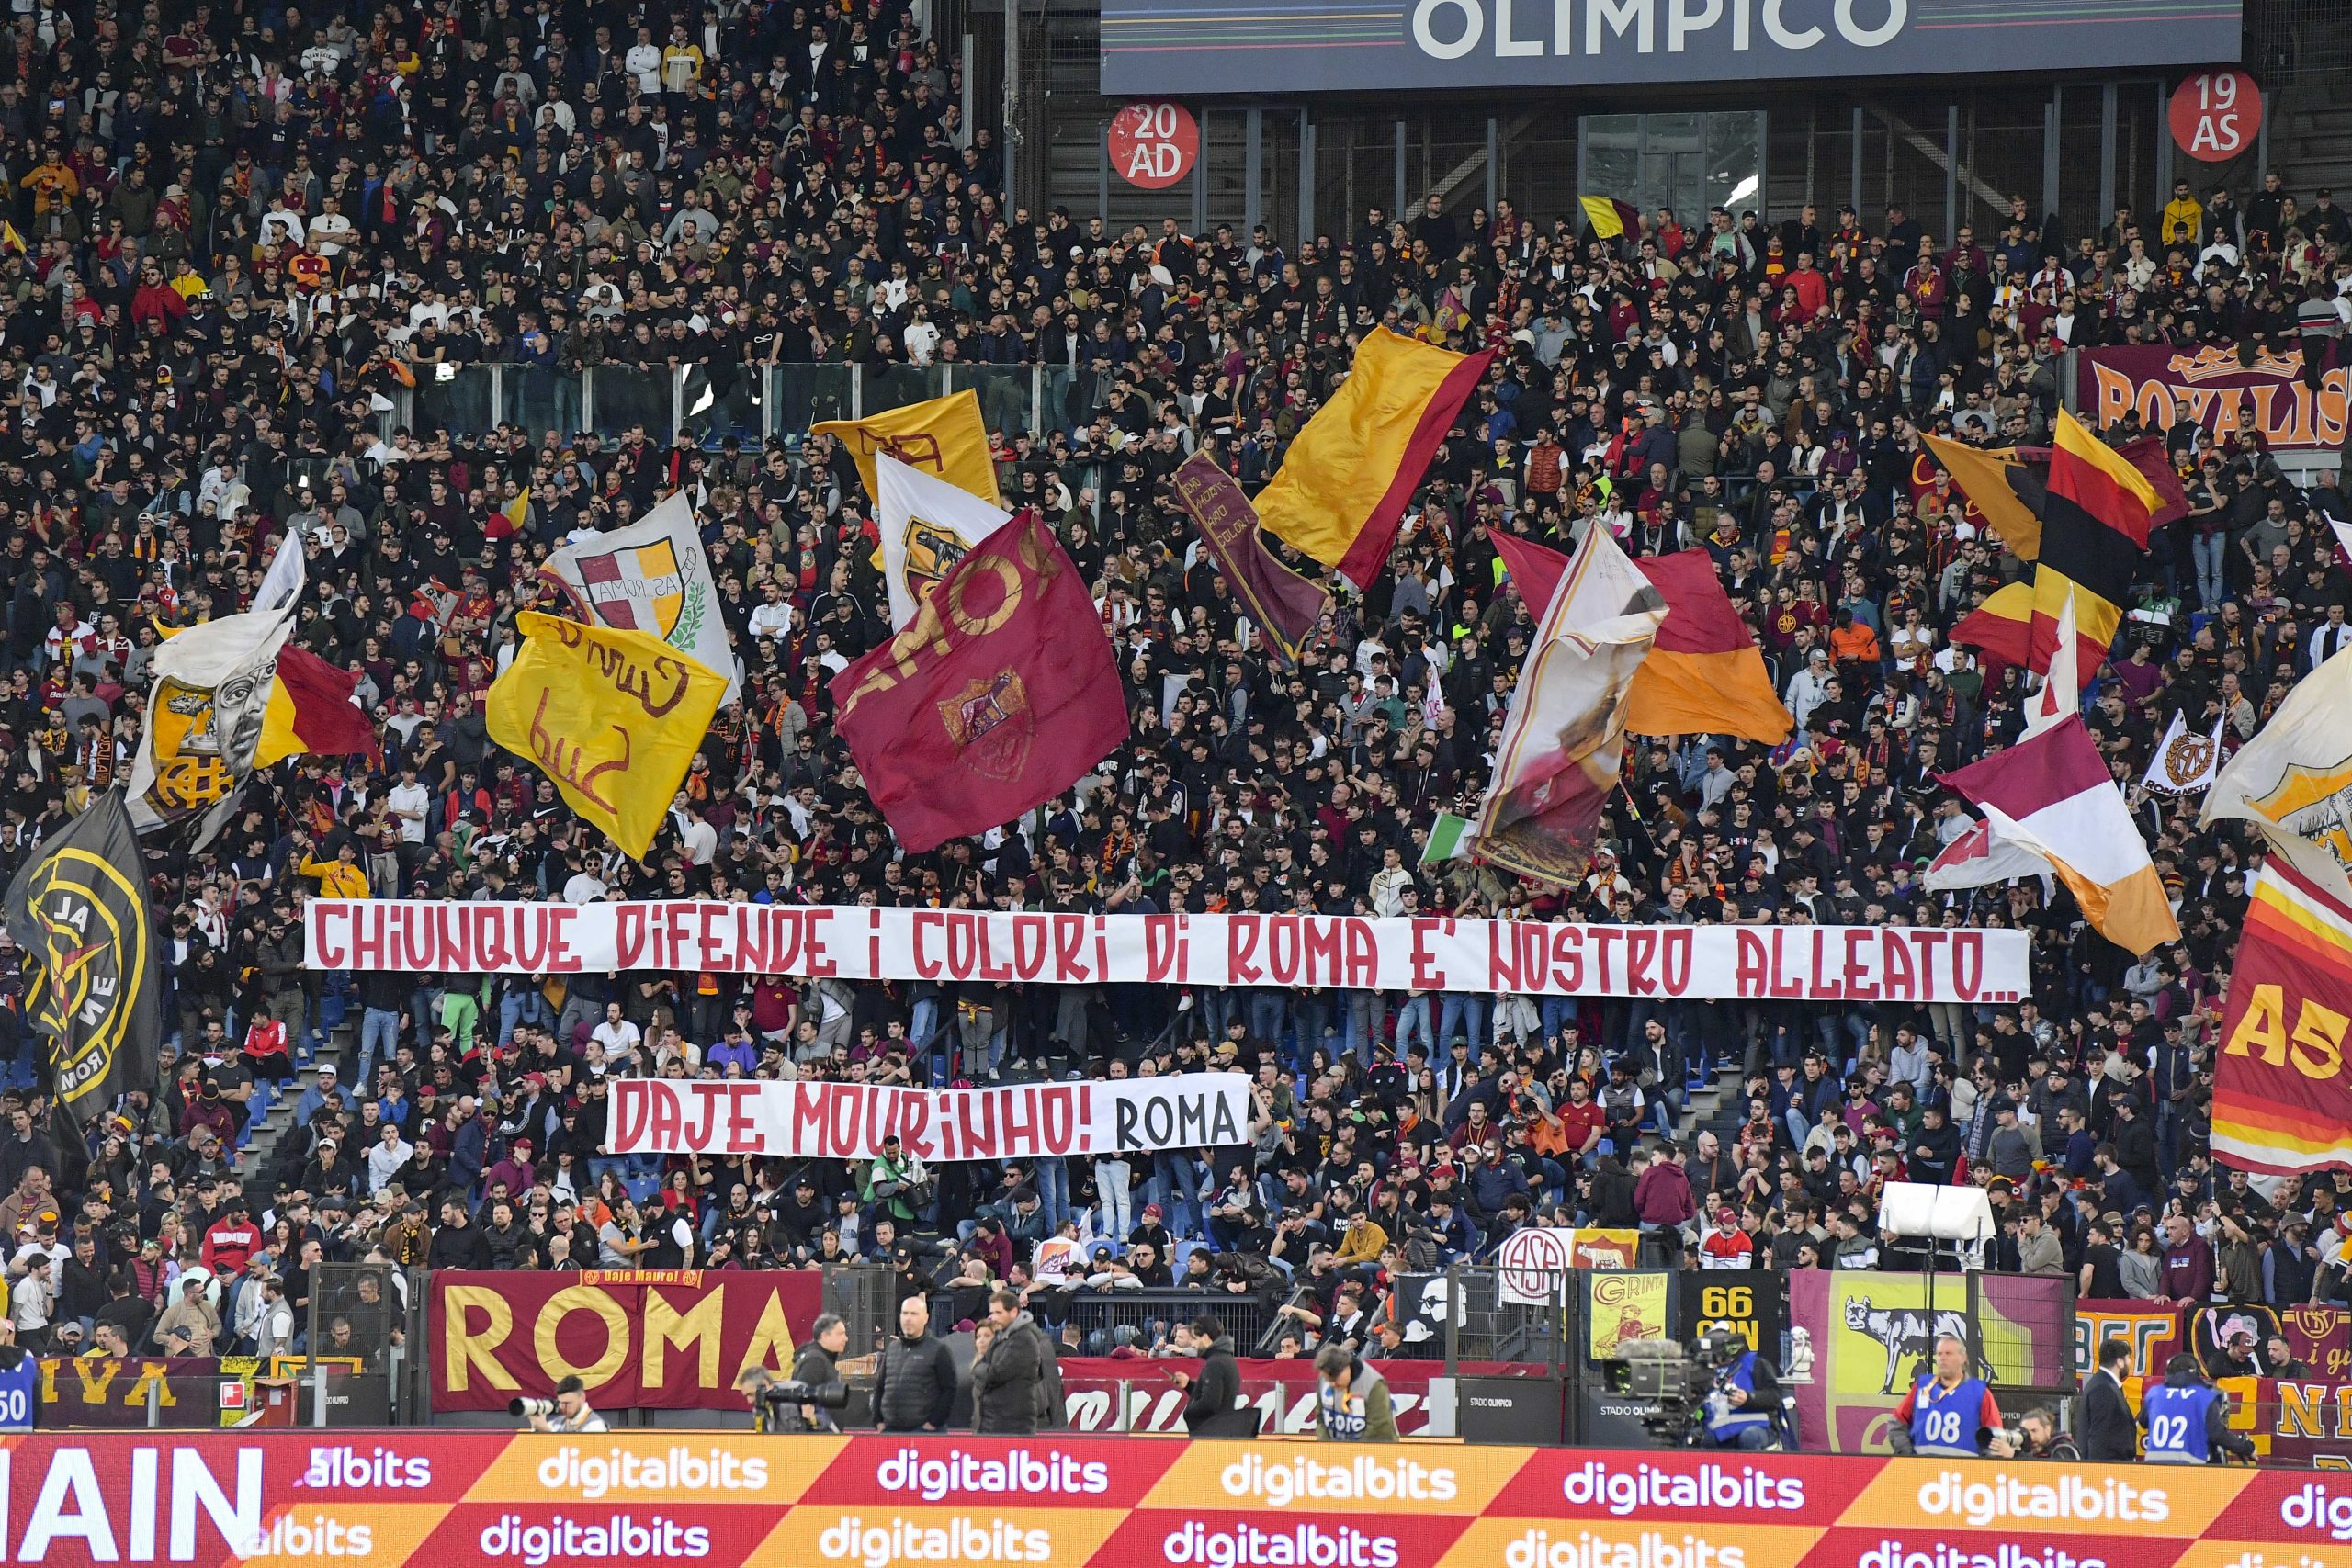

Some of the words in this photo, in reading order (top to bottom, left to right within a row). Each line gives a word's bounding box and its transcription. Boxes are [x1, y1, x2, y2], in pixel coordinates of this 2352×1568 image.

[1412, 0, 1908, 59] OLIMPICO
[2194, 73, 2237, 110] 19
[1134, 103, 1177, 139] 20
[2190, 114, 2240, 152] AS
[1127, 143, 1182, 178] AD
[2091, 358, 2352, 446] ROYALIS
[1227, 915, 1379, 987] ROMA
[1488, 920, 1693, 998] NOSTRO
[1736, 927, 2019, 1002] ALLEATO...
[613, 1081, 765, 1154] DAJE
[1115, 1089, 1238, 1152] ROMA
[604, 1269, 631, 1283] Daje
[635, 1269, 679, 1283] Mauro!
[1593, 1275, 1665, 1305] GRINTA
[1702, 1286, 1753, 1318] 66
[445, 1282, 797, 1391] ROMA
[1470, 1397, 1487, 1407] STADIO
[1488, 1398, 1513, 1408] OLIMPICO
[1600, 1406, 1632, 1416] STADIO
[2165, 1388, 2196, 1400] TV
[1925, 1411, 1961, 1444] 08
[2152, 1415, 2188, 1449] 02
[537, 1446, 768, 1498] digitalbits
[877, 1448, 1108, 1501] digitalbits
[1221, 1452, 1457, 1506] digitalbits
[1563, 1461, 1805, 1516] digitalbits
[0, 1447, 264, 1562] AIN
[1917, 1471, 2170, 1527] digitalbits
[480, 1514, 710, 1565] digitalbits
[819, 1516, 1051, 1568] digitalbits
[1163, 1520, 1398, 1568] digitalbits
[1505, 1529, 1745, 1568] digitalbits
